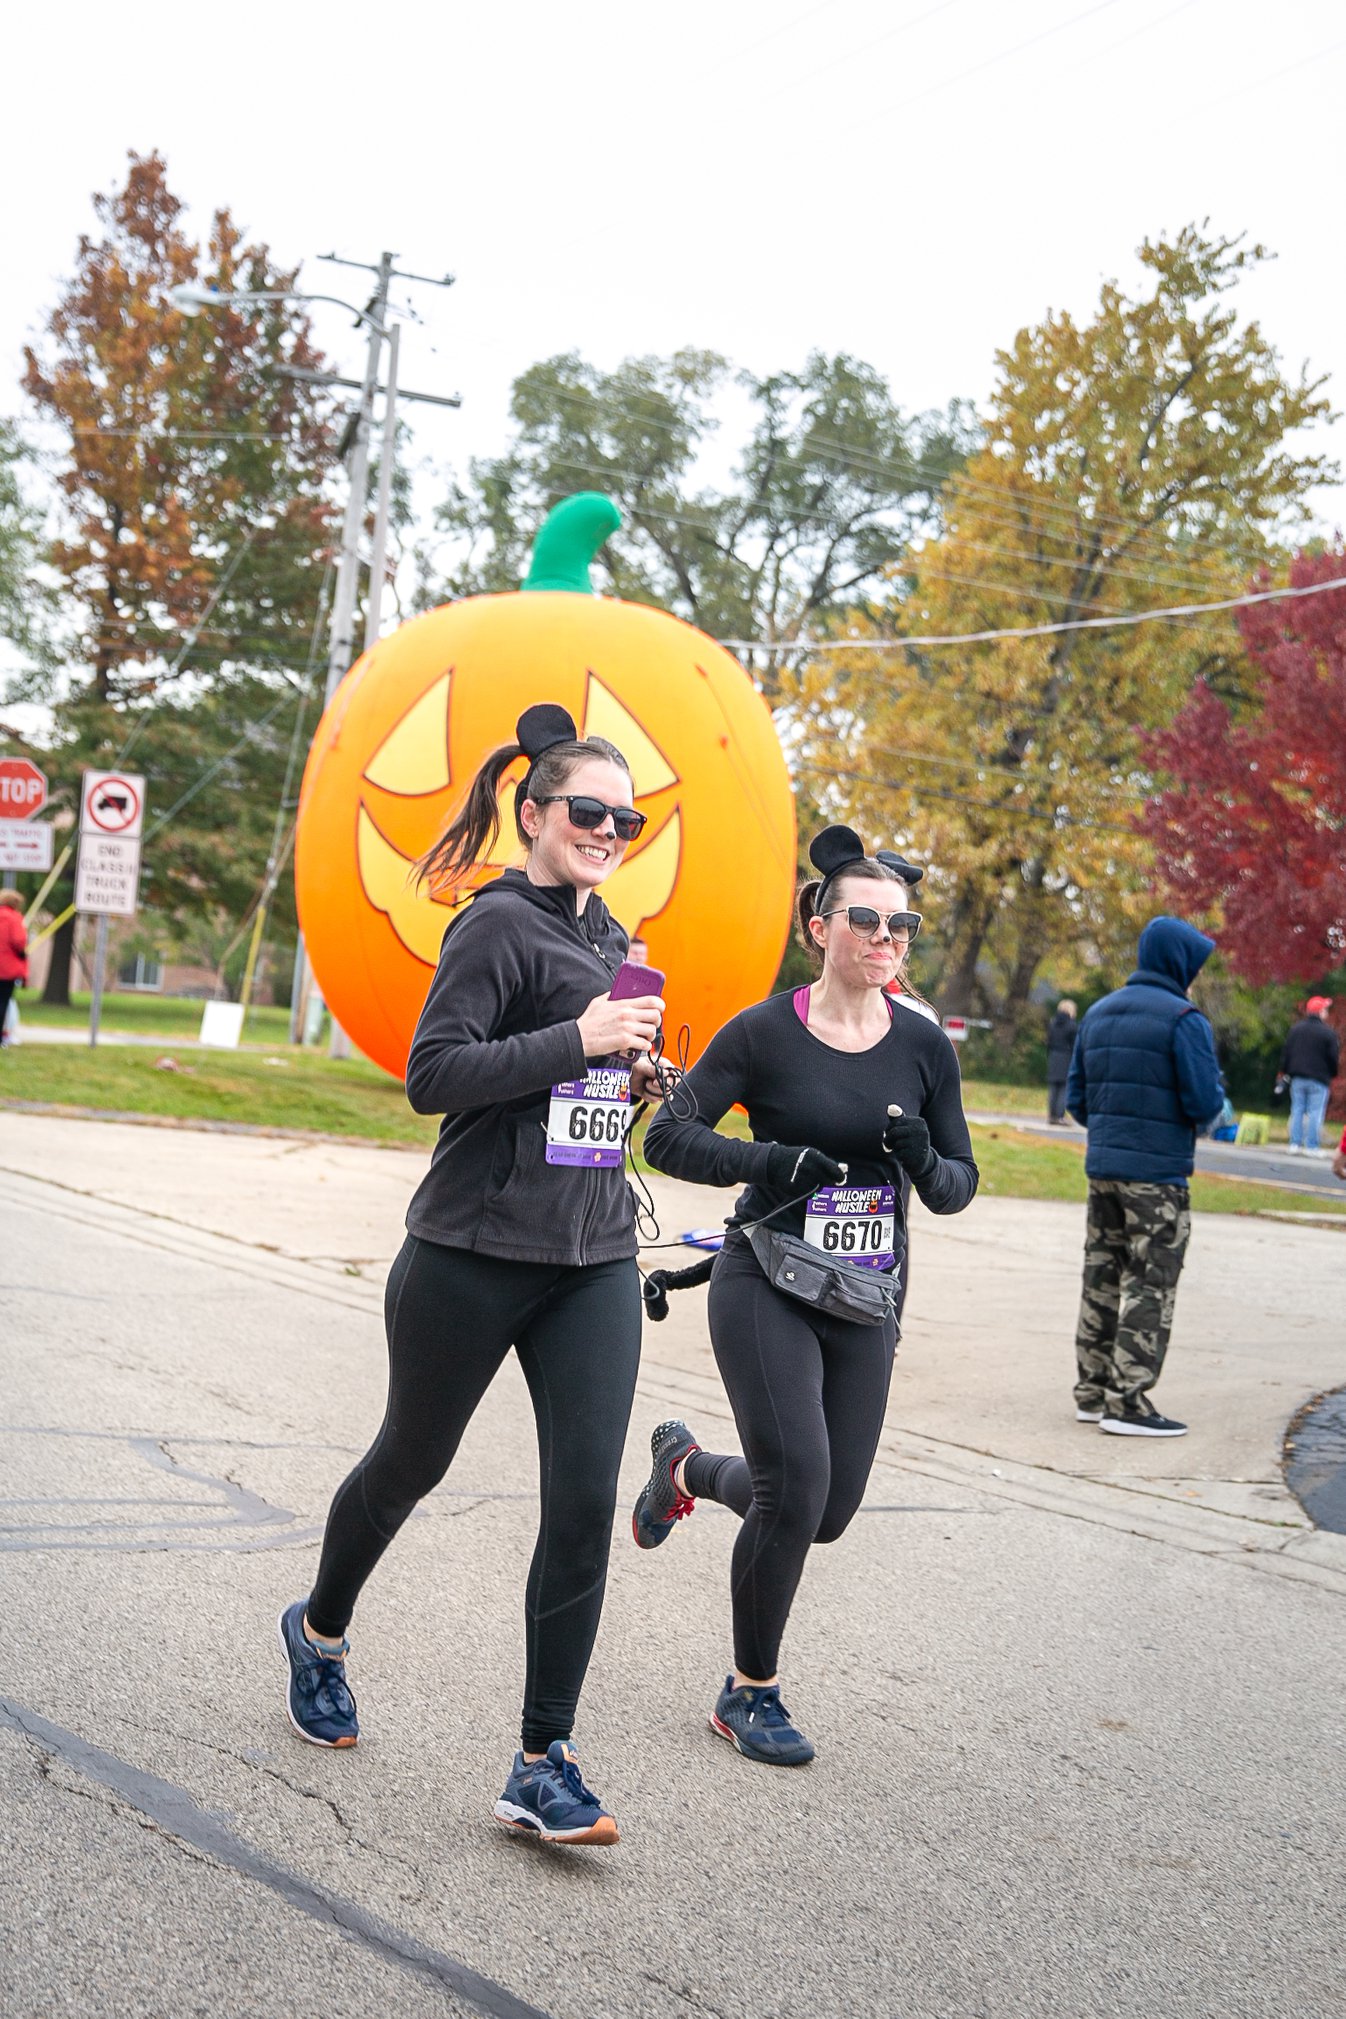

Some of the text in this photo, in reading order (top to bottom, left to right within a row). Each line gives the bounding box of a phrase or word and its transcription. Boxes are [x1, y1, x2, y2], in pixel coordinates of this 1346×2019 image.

[0, 776, 43, 803] TOP
[99, 844, 121, 858] END
[86, 874, 127, 890] TRUCK
[84, 891, 127, 907] ROUTE
[580, 1070, 630, 1089] ALLOWEEN
[583, 1084, 620, 1099] HUSTLE
[831, 1189, 882, 1202] HALLOWEEN
[835, 1201, 870, 1214] HUSTLE
[823, 1219, 882, 1251] 6670
